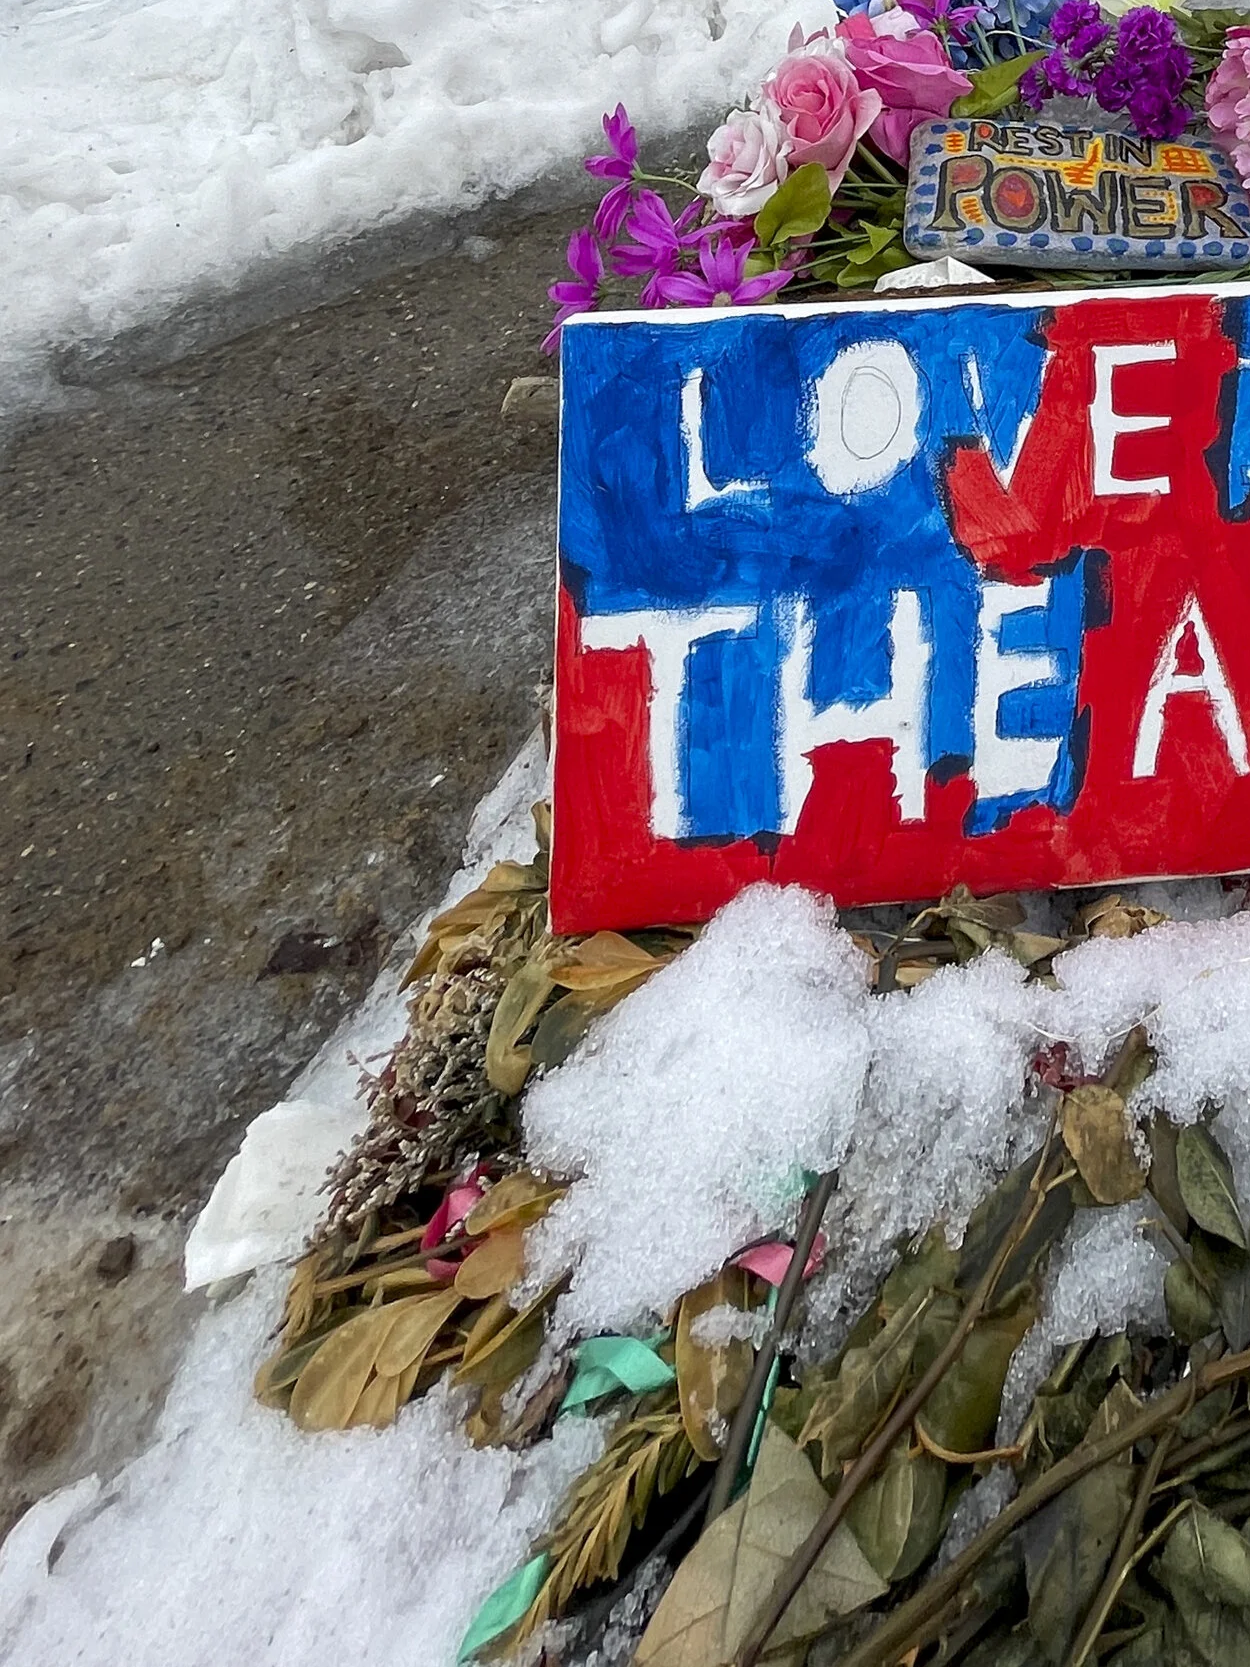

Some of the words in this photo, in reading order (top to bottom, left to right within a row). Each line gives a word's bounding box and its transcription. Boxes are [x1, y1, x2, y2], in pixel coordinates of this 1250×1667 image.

[926, 155, 1249, 239] POWER
[968, 121, 1094, 157] REST
[1104, 133, 1153, 167] IN
[677, 337, 1180, 512] LOVE
[580, 580, 1064, 840] THE
